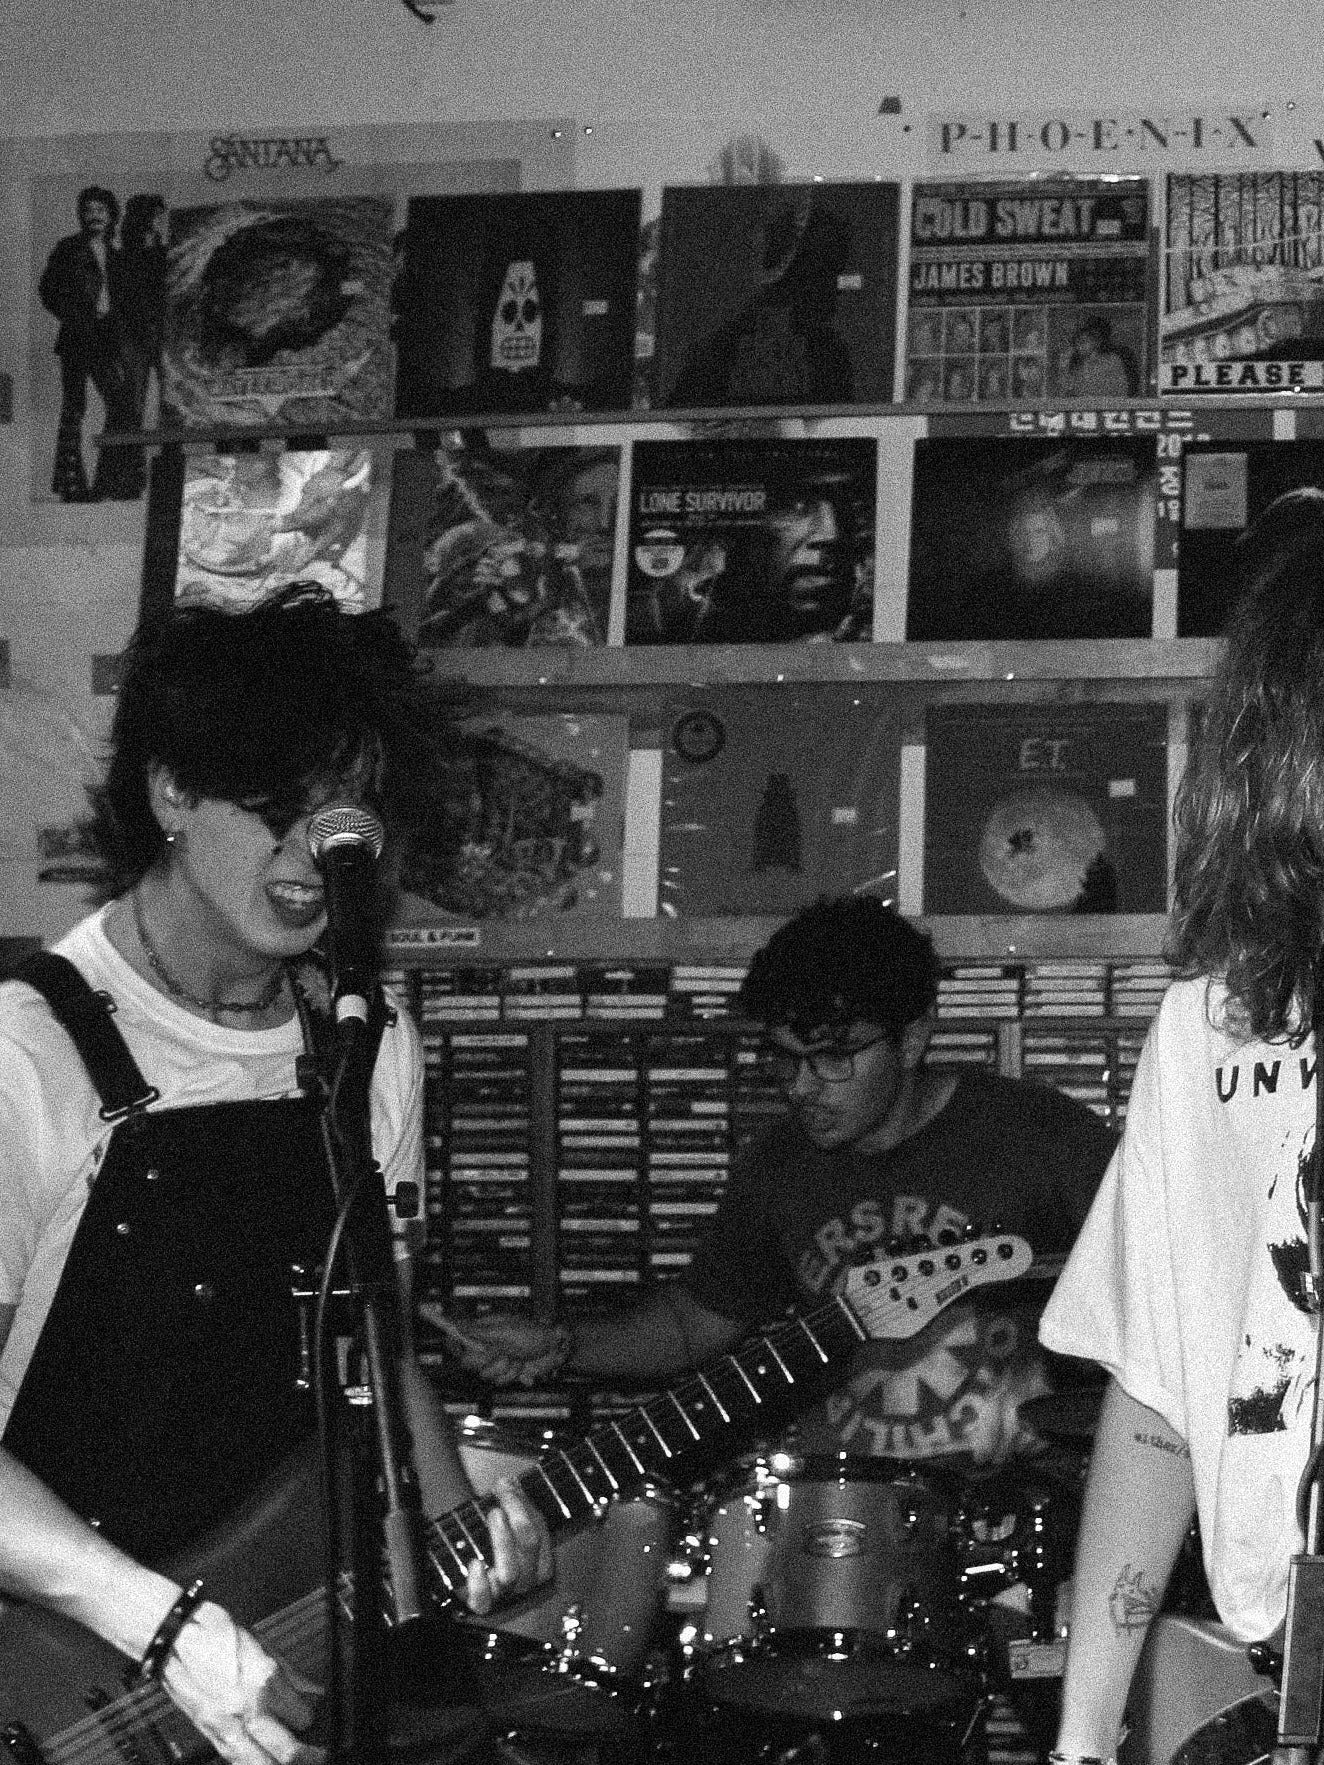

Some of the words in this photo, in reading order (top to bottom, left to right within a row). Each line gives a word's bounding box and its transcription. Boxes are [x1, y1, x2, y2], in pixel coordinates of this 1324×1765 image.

[204, 133, 346, 183] SANTANA
[915, 198, 987, 238] COLD
[996, 197, 1097, 237] SWEAT
[914, 263, 985, 290] JAMES
[992, 261, 1069, 289] BROWN
[1170, 362, 1305, 387] PLEASE
[639, 492, 682, 513] LONE
[685, 490, 767, 513] SURVIVOR
